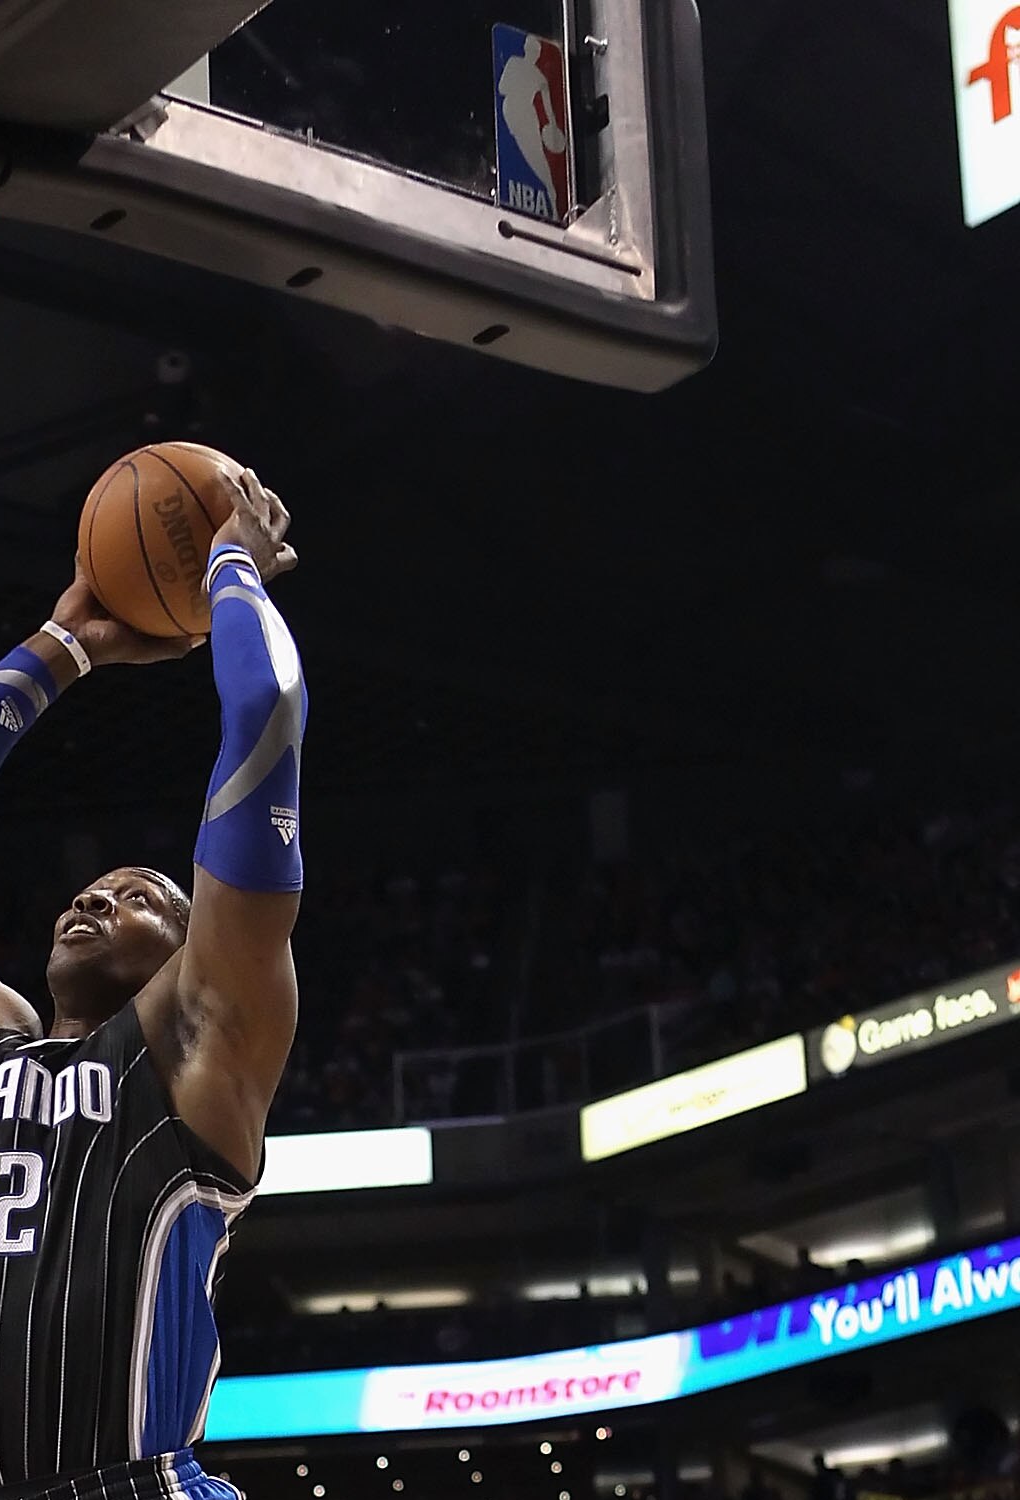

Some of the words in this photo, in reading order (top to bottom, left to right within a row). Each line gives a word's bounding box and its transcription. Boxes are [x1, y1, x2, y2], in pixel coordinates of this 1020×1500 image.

[508, 180, 549, 218] NBA
[858, 1009, 934, 1054] Game
[810, 1271, 921, 1345] You'll
[423, 1368, 641, 1413] RoomStore
